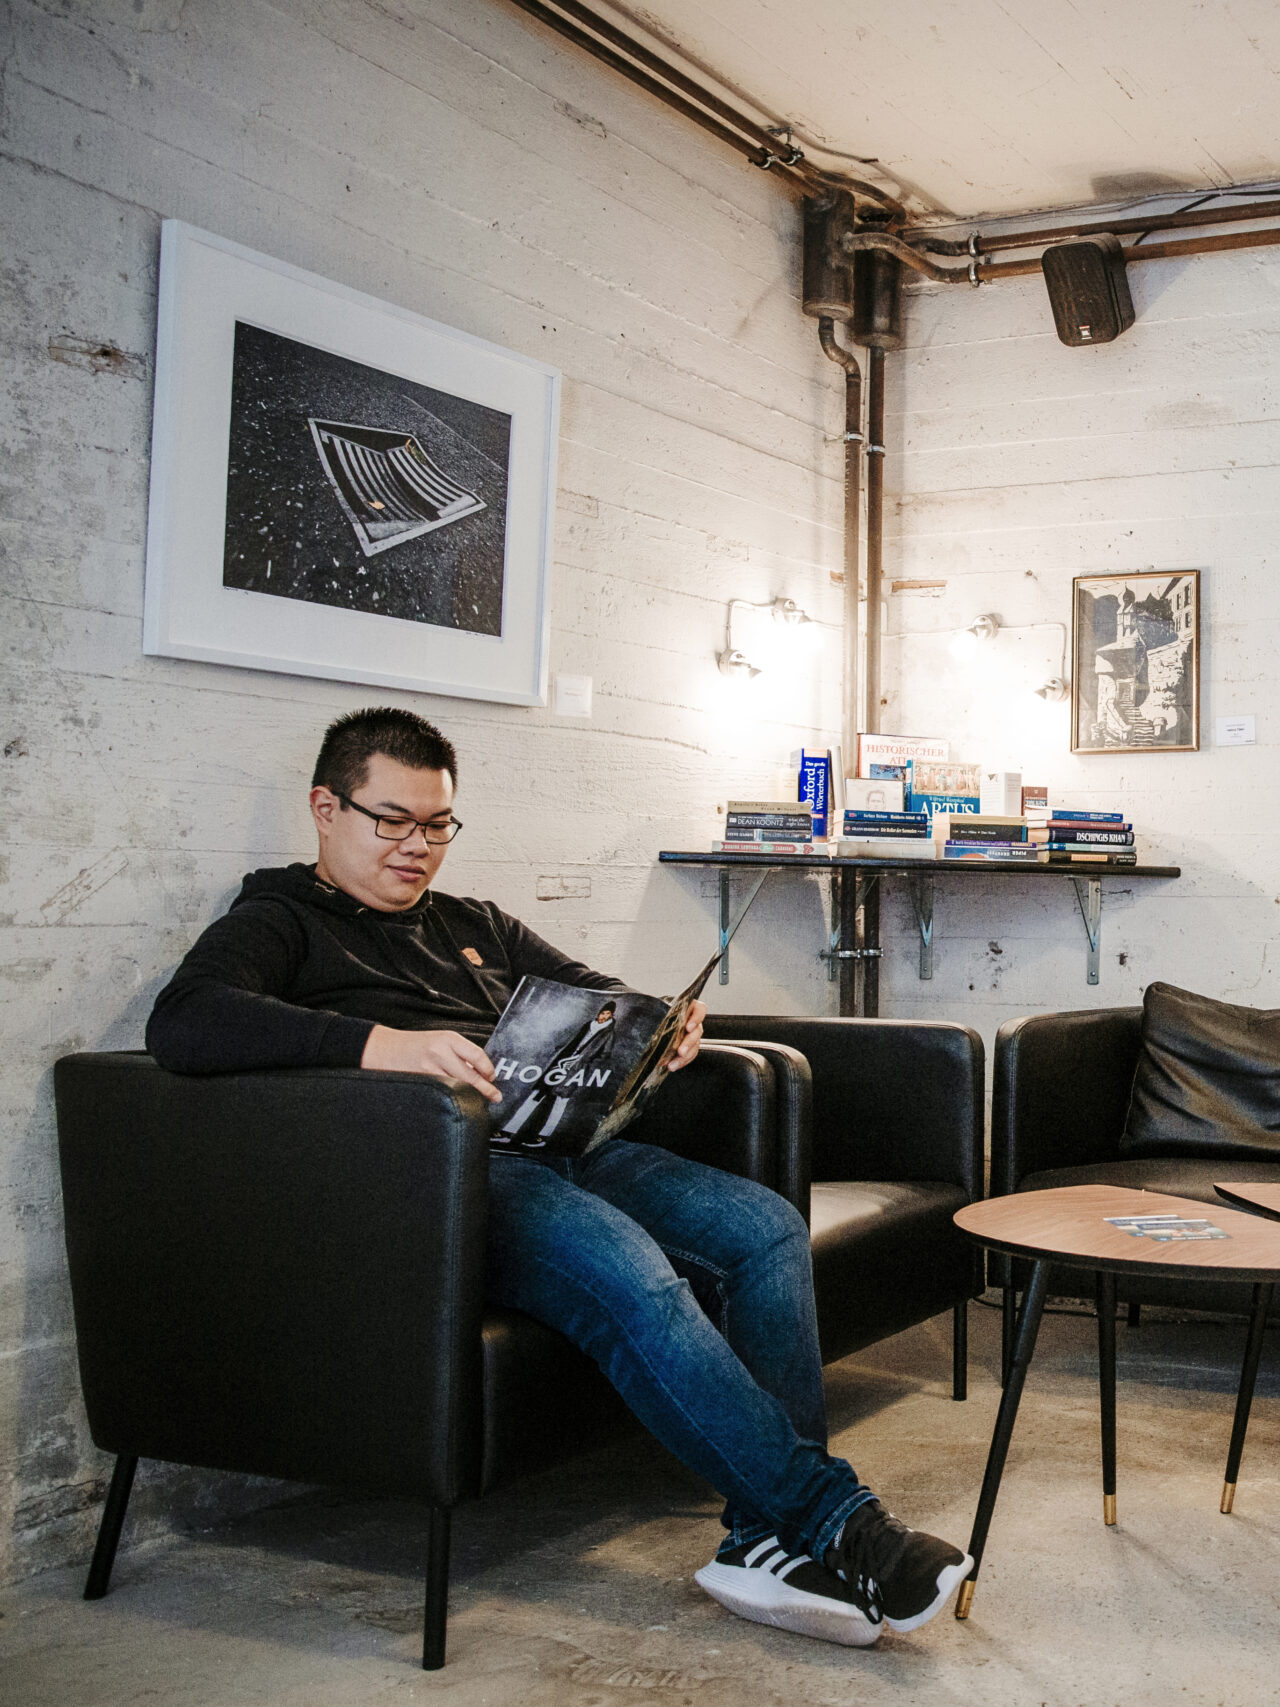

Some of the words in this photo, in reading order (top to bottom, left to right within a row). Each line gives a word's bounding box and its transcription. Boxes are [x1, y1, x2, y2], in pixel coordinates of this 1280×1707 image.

[866, 744, 944, 757] HISTORISCHER
[816, 769, 825, 810] Wörterbuch
[756, 819, 784, 827] KOONTZ
[1076, 832, 1109, 842] DSCHINGIS
[1109, 833, 1126, 843] KHAN
[494, 1057, 612, 1088] HOGAN
